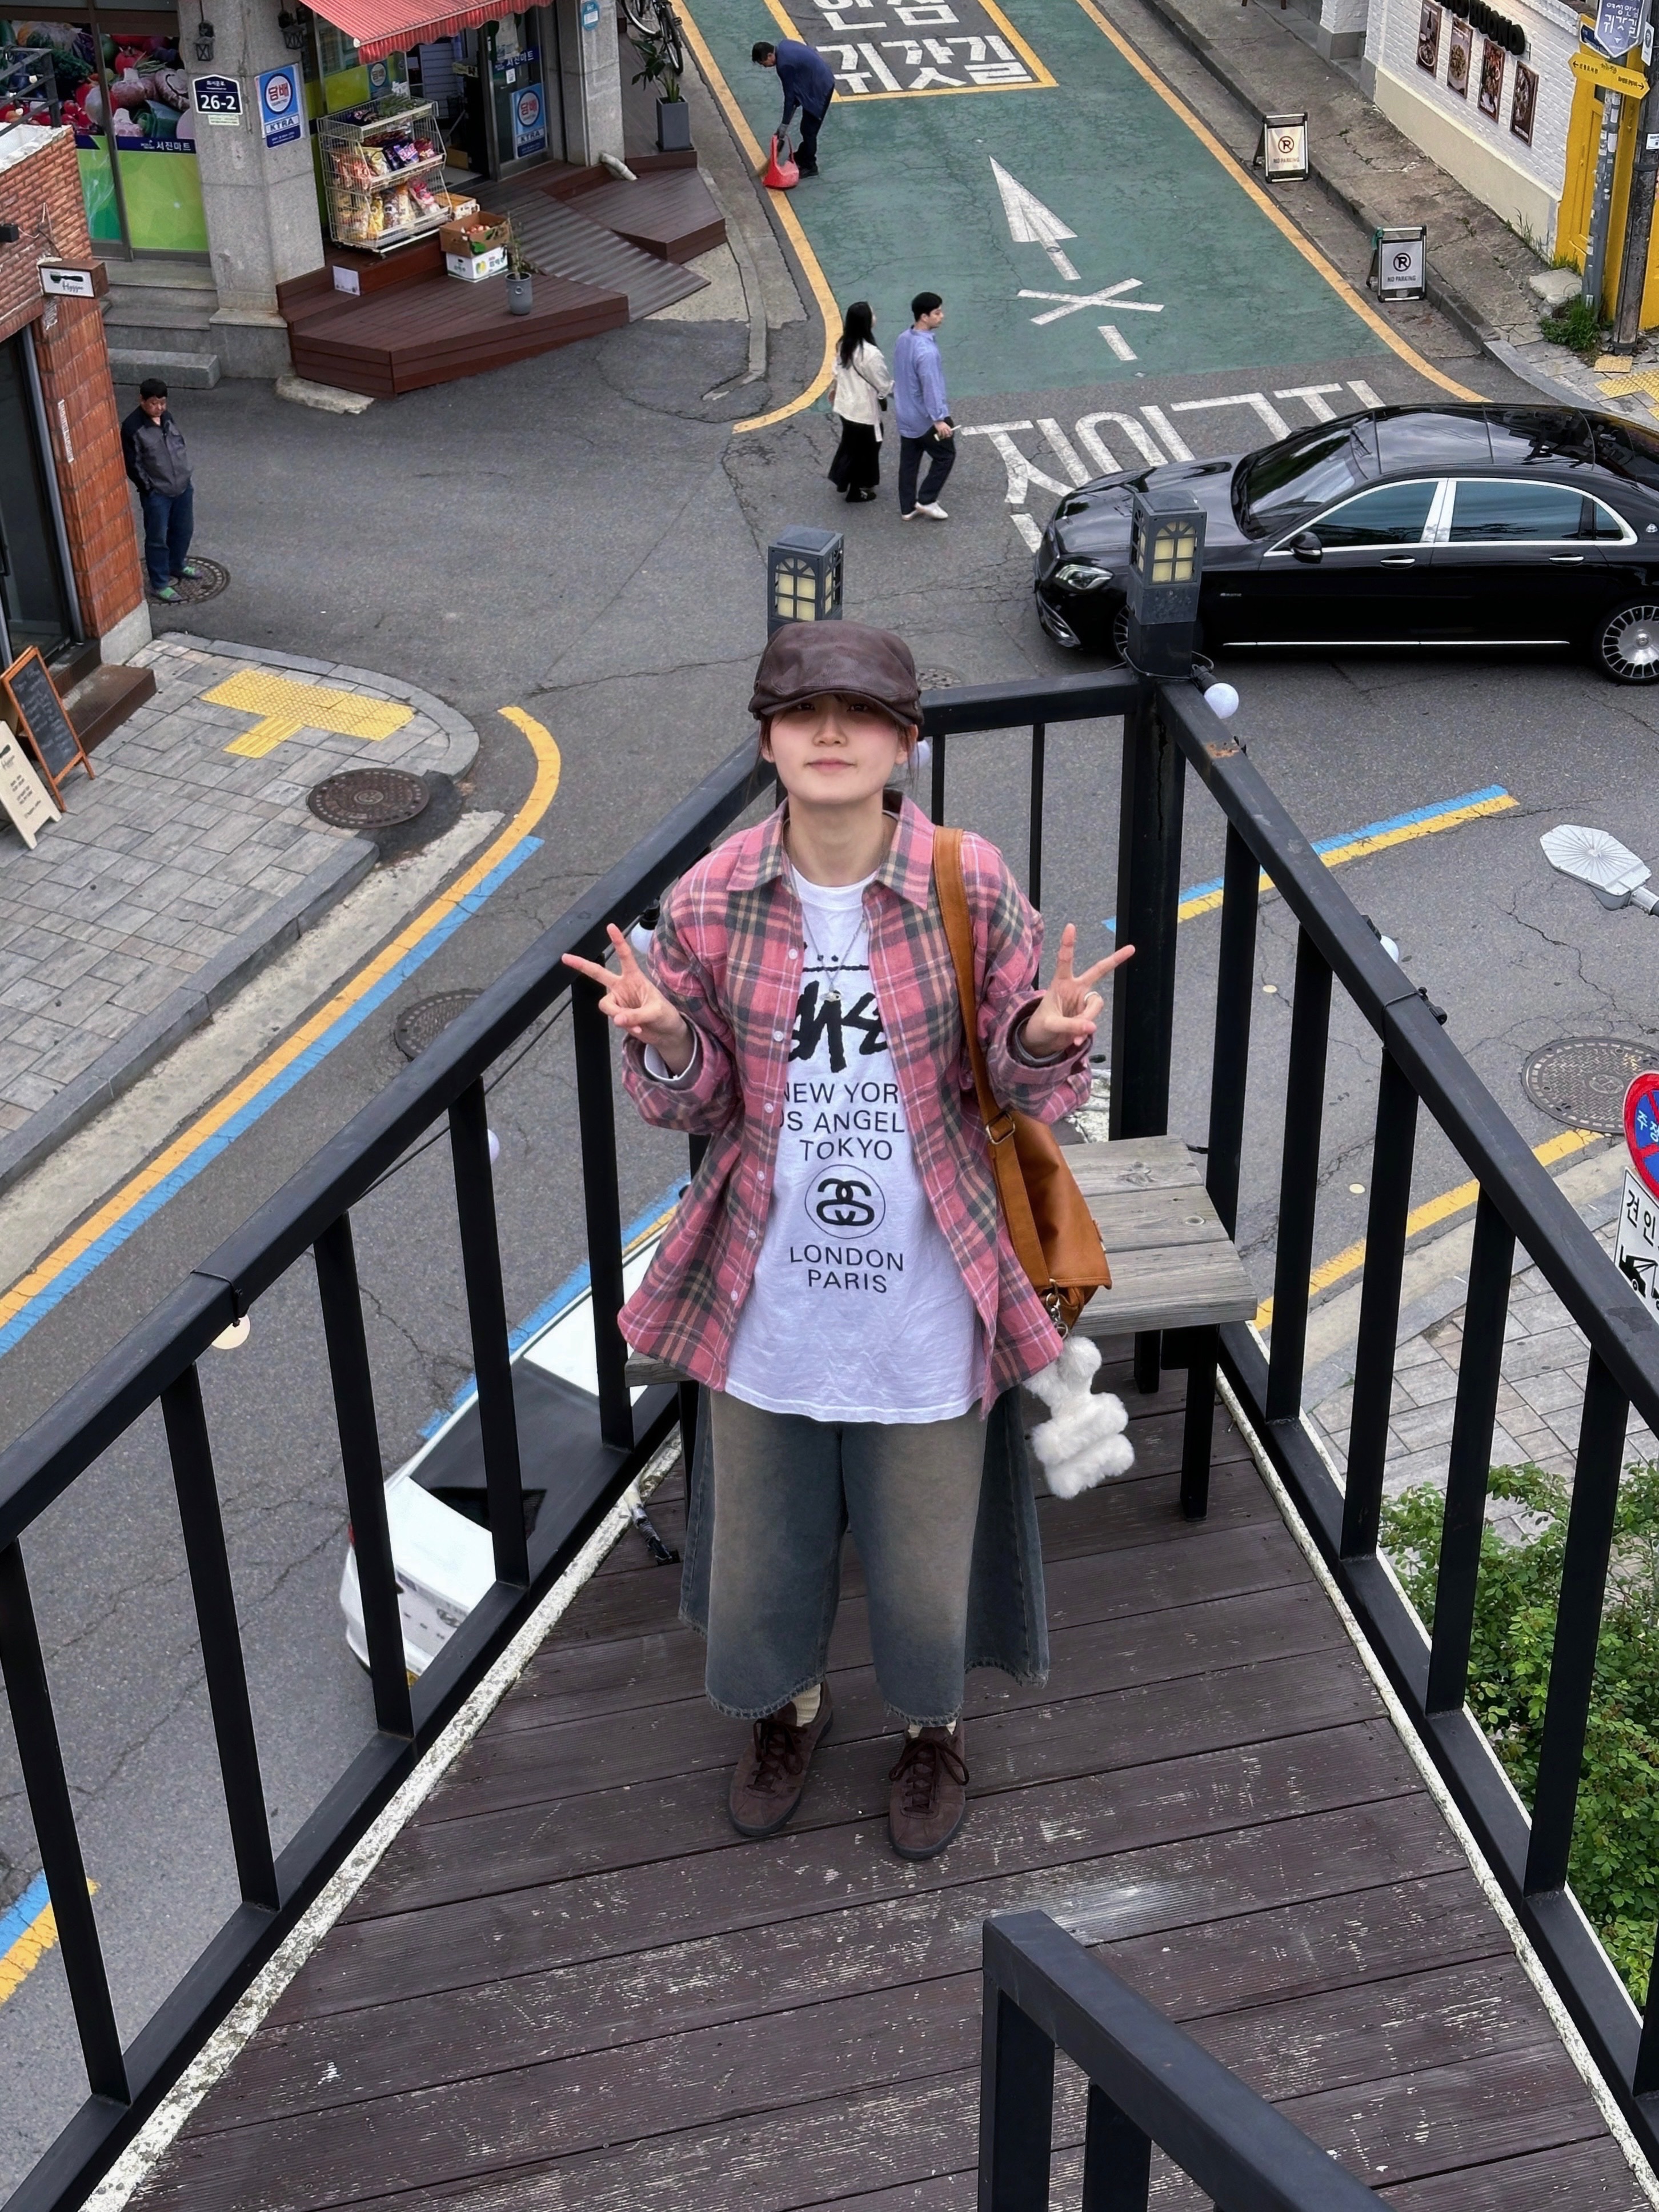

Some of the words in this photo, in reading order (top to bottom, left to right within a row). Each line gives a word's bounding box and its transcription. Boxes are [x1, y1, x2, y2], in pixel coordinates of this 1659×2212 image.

[1604, 14, 1637, 34] 귀갓길
[816, 35, 1033, 93] 귀갓길
[201, 95, 237, 110] 26-2
[269, 82, 289, 101] 담배
[270, 118, 294, 131] KTRA
[157, 141, 191, 151] 서진마트
[520, 130, 540, 143] KTRA
[843, 1082, 899, 1104] YOR
[814, 1110, 905, 1133] ANGEL
[800, 1137, 893, 1161] TOKYO
[1626, 1189, 1659, 1250] 견인
[789, 1244, 904, 1272] LONDON
[807, 1268, 888, 1295] PARIS
